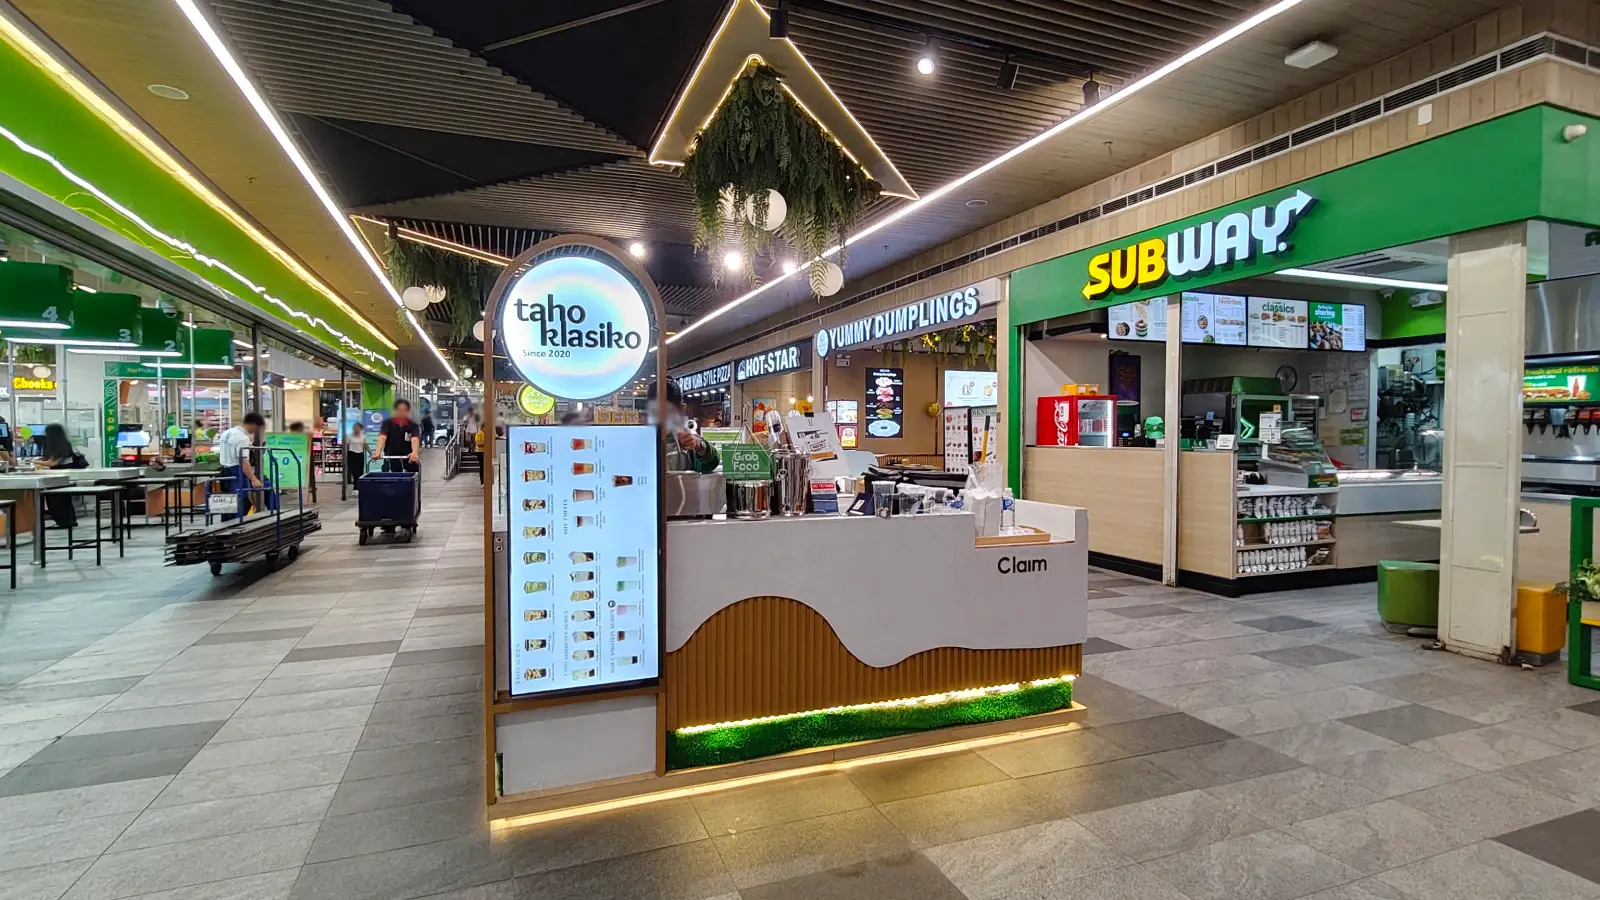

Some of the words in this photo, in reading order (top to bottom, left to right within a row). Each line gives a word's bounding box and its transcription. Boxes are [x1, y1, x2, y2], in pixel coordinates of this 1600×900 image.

[1081, 189, 1312, 300] SUBWAY
[42, 306, 58, 321] 4
[513, 294, 586, 324] taho
[1262, 302, 1295, 313] classics
[829, 318, 873, 349] YUMMY
[874, 287, 978, 339] DUMPLINGS
[118, 329, 131, 342] 3
[540, 321, 642, 350] klasiko
[164, 340, 176, 352] 2
[522, 350, 546, 358] Since
[548, 350, 571, 358] 2020
[221, 356, 229, 365] 1
[745, 346, 798, 378] HOT-STAR
[703, 370, 716, 387] STYLE
[107, 408, 115, 432] TOP
[734, 451, 759, 461] Grab
[733, 461, 760, 471] Food
[997, 556, 1048, 574] Claim
